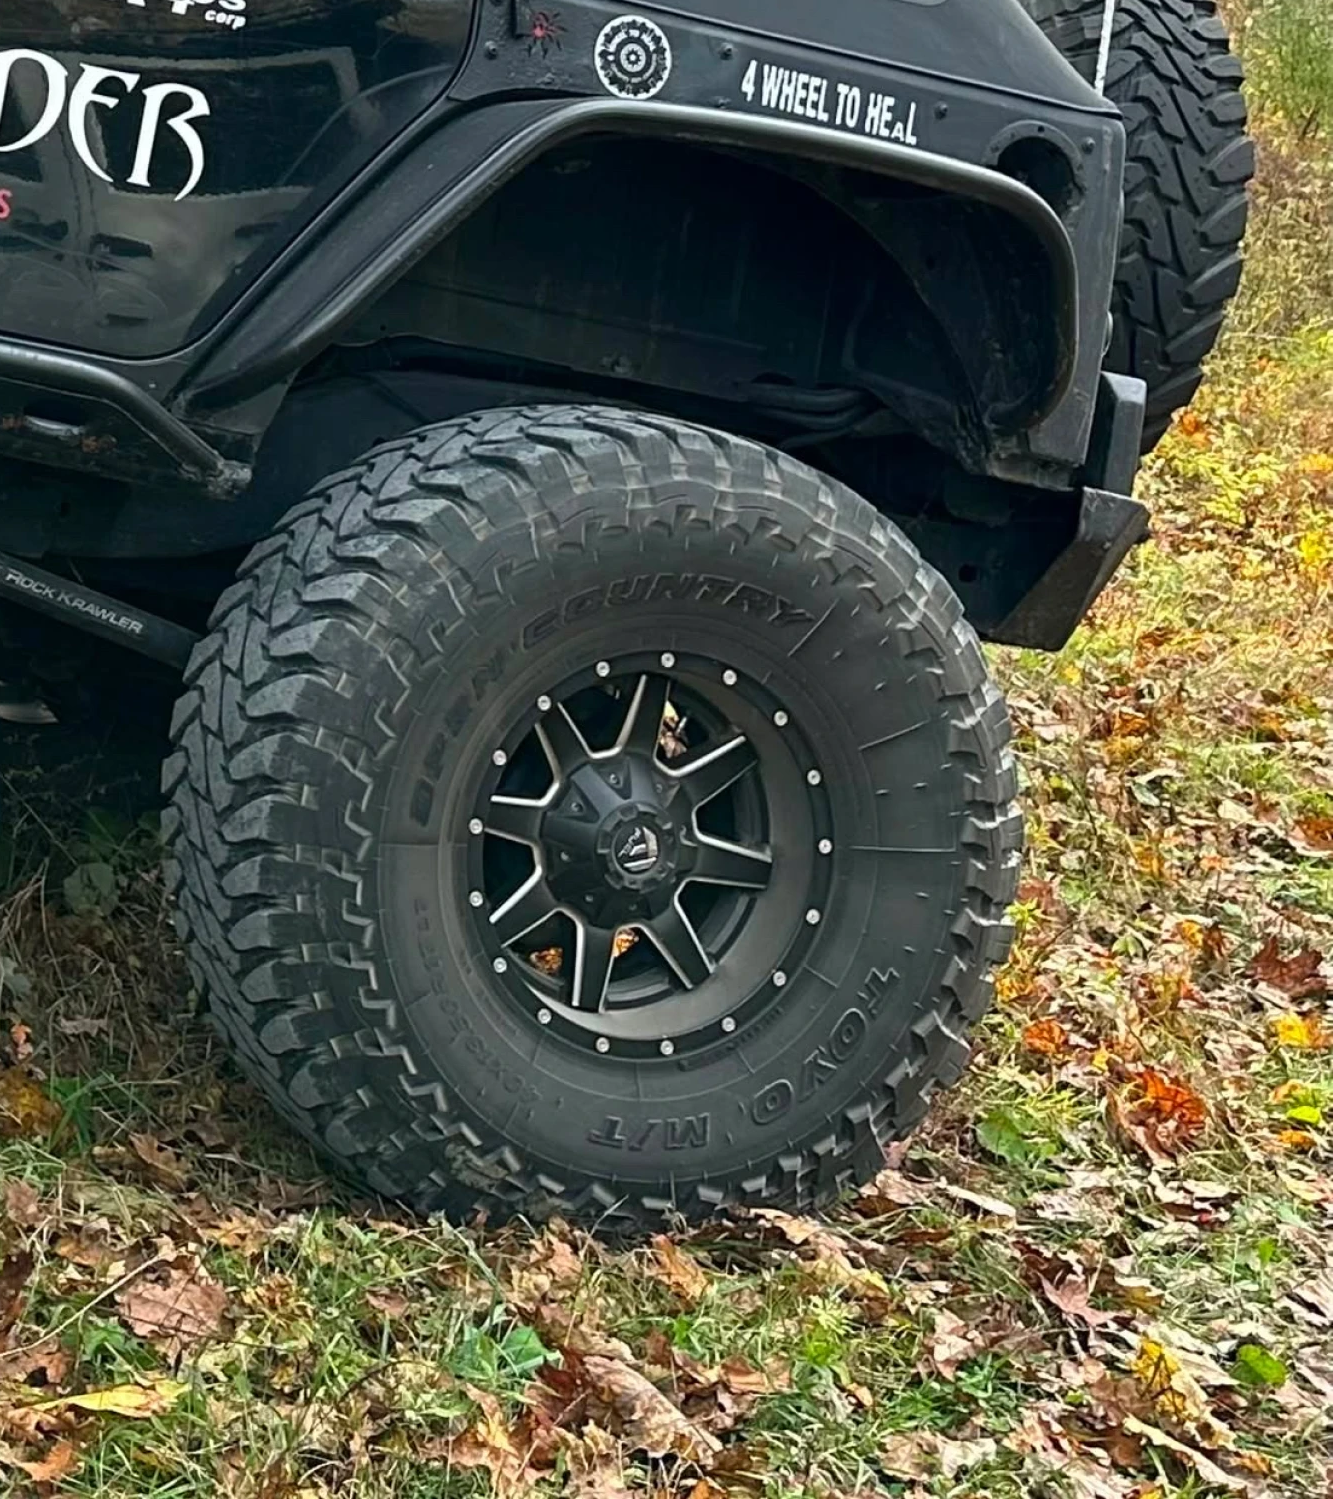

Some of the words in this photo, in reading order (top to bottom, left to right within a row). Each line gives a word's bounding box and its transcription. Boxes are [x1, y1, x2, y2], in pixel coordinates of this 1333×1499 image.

[741, 59, 757, 102] 4
[761, 64, 829, 122] WHEEL
[835, 82, 859, 127] TO
[5, 568, 55, 599] ROCK
[56, 591, 144, 634] KRAWLER
[519, 571, 816, 653] COUNTRY
[751, 966, 902, 1126] TOYO
